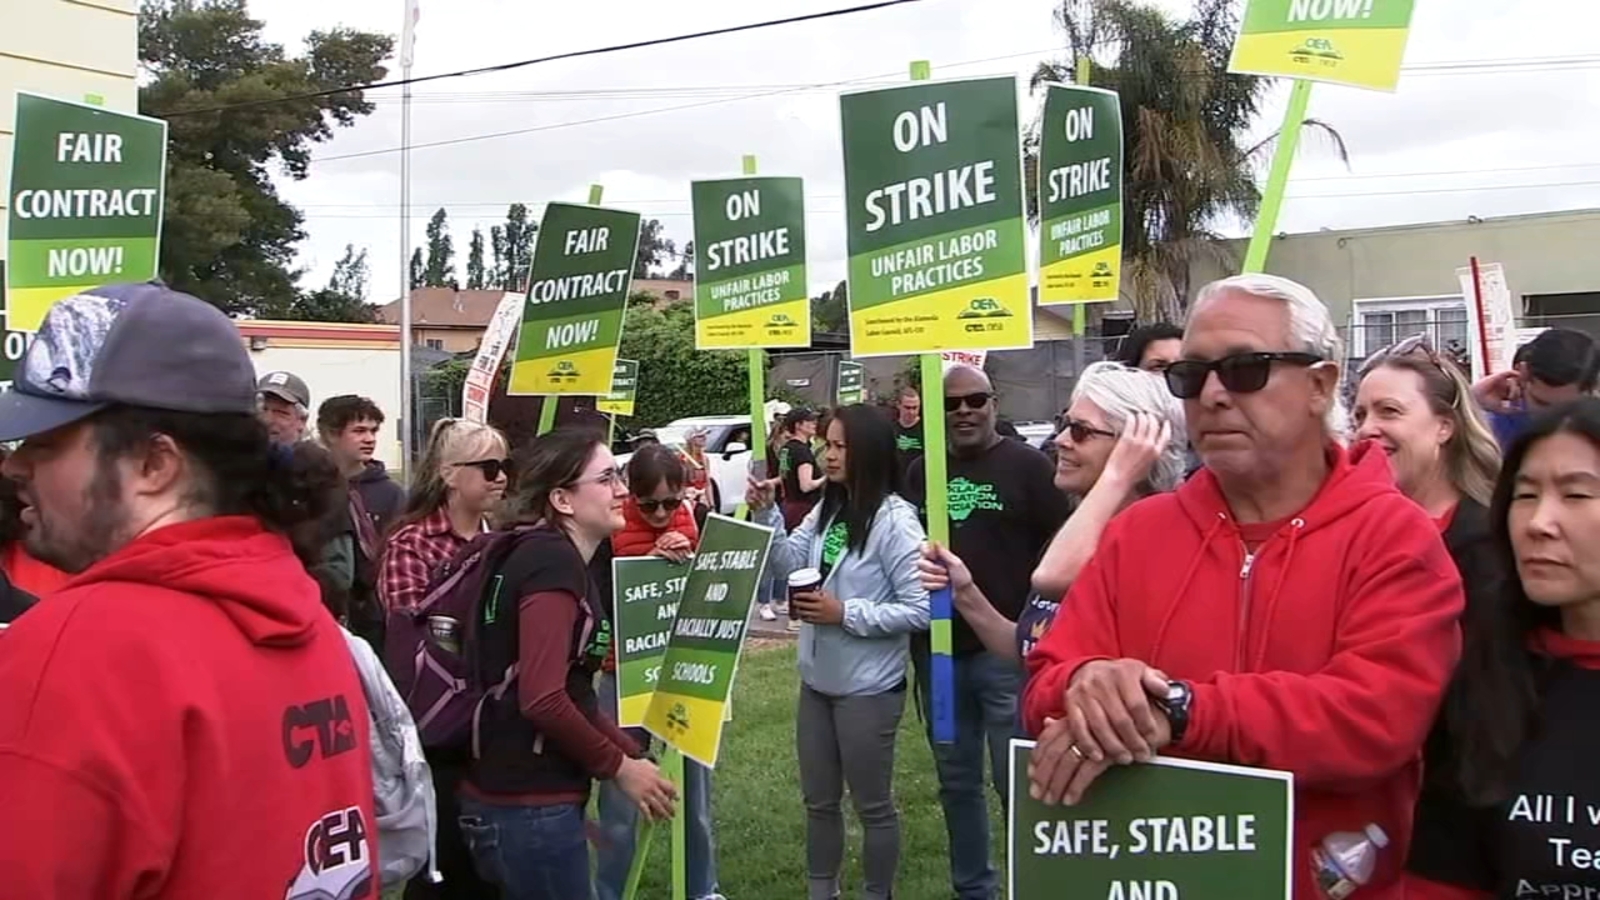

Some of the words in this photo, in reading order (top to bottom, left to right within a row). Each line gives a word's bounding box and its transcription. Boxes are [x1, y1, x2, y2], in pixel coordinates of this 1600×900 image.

[1287, 0, 1373, 22] NOW!
[893, 102, 947, 152] ON
[1065, 107, 1093, 142] ON
[57, 132, 122, 163] FAIR
[1049, 157, 1110, 203] STRIKE
[15, 189, 156, 218] CONTRACT
[726, 189, 759, 220] ON
[865, 160, 996, 231] STRIKE
[1051, 217, 1081, 240] UNFAIR
[1083, 209, 1110, 230] LABOR
[564, 227, 609, 255] FAIR
[708, 227, 789, 270] STRIKE
[872, 241, 934, 277] UNFAIR
[939, 229, 997, 260] LABOR
[1060, 230, 1104, 257] PRACTICES
[48, 247, 123, 277] NOW!
[892, 257, 983, 295] PRACTICES
[530, 269, 628, 304] CONTRACT
[710, 279, 751, 299] UNFAIR
[753, 270, 790, 289] LABOR
[724, 288, 781, 312] PRACTICES
[546, 319, 599, 349] NOW!
[695, 552, 718, 572] SAFE,
[719, 550, 758, 570] STABLE
[625, 582, 662, 602] SAFE,
[705, 583, 728, 602] AND
[657, 602, 680, 620] AN
[675, 618, 717, 638] RACIALLY
[715, 620, 744, 640] JUST
[671, 662, 717, 684] SCHOOLS
[282, 694, 357, 770] CTA
[1508, 794, 1552, 822] All
[1567, 796, 1575, 823] I
[306, 807, 368, 876] OEA
[1034, 820, 1120, 859] SAFE,
[1128, 814, 1256, 853] STABLE
[1107, 880, 1178, 900] AND
